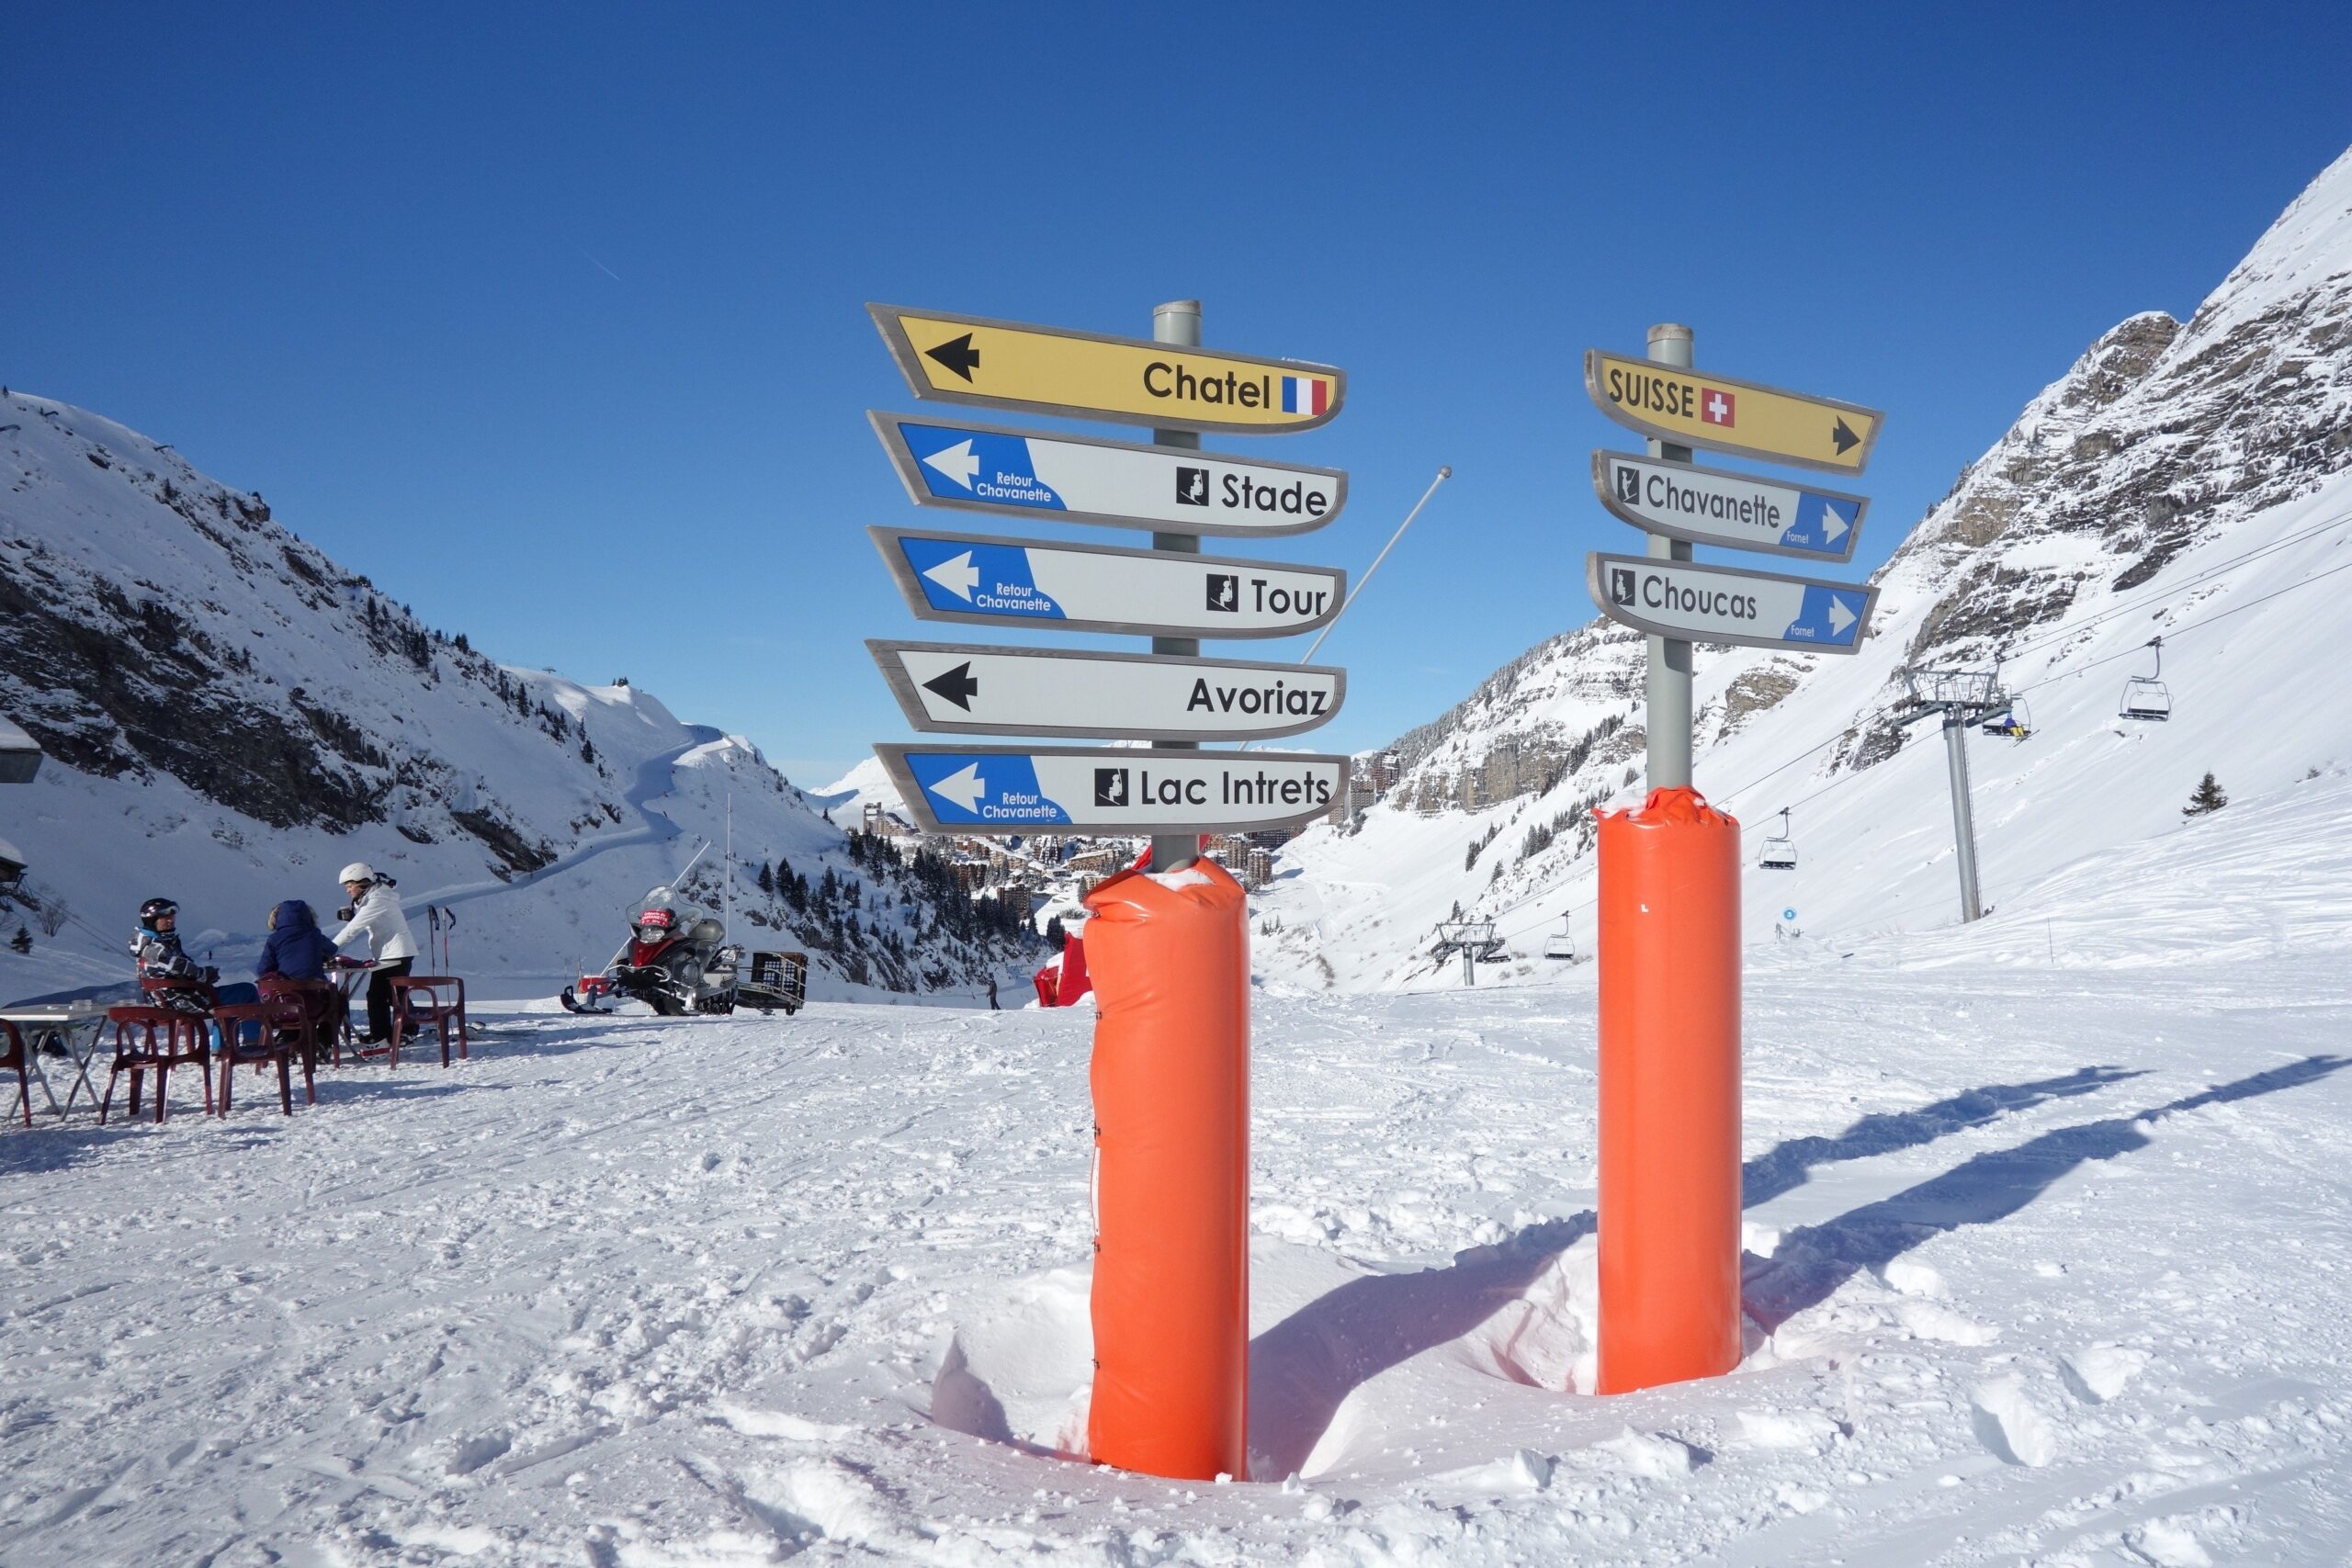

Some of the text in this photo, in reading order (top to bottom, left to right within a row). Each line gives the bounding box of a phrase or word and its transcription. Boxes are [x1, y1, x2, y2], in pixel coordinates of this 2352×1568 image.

[1143, 361, 1272, 410] Chatel
[1609, 368, 1694, 418] SUISSE
[977, 483, 1052, 502] Chavanette
[997, 471, 1033, 487] Retour
[1221, 473, 1329, 517] Stade
[1646, 474, 1781, 529] Chavanette
[1786, 531, 1809, 545] Fornet
[976, 594, 1051, 612] Chavanette
[996, 582, 1033, 597] Retour
[1250, 579, 1327, 616] Tour
[1643, 575, 1757, 620] Choucas
[1791, 625, 1815, 637] Fornet
[1186, 678, 1329, 716] Avoriaz
[1002, 792, 1038, 805] Retour
[1141, 770, 1330, 807] Lac Intrets
[982, 805, 1057, 818] Chavanette
